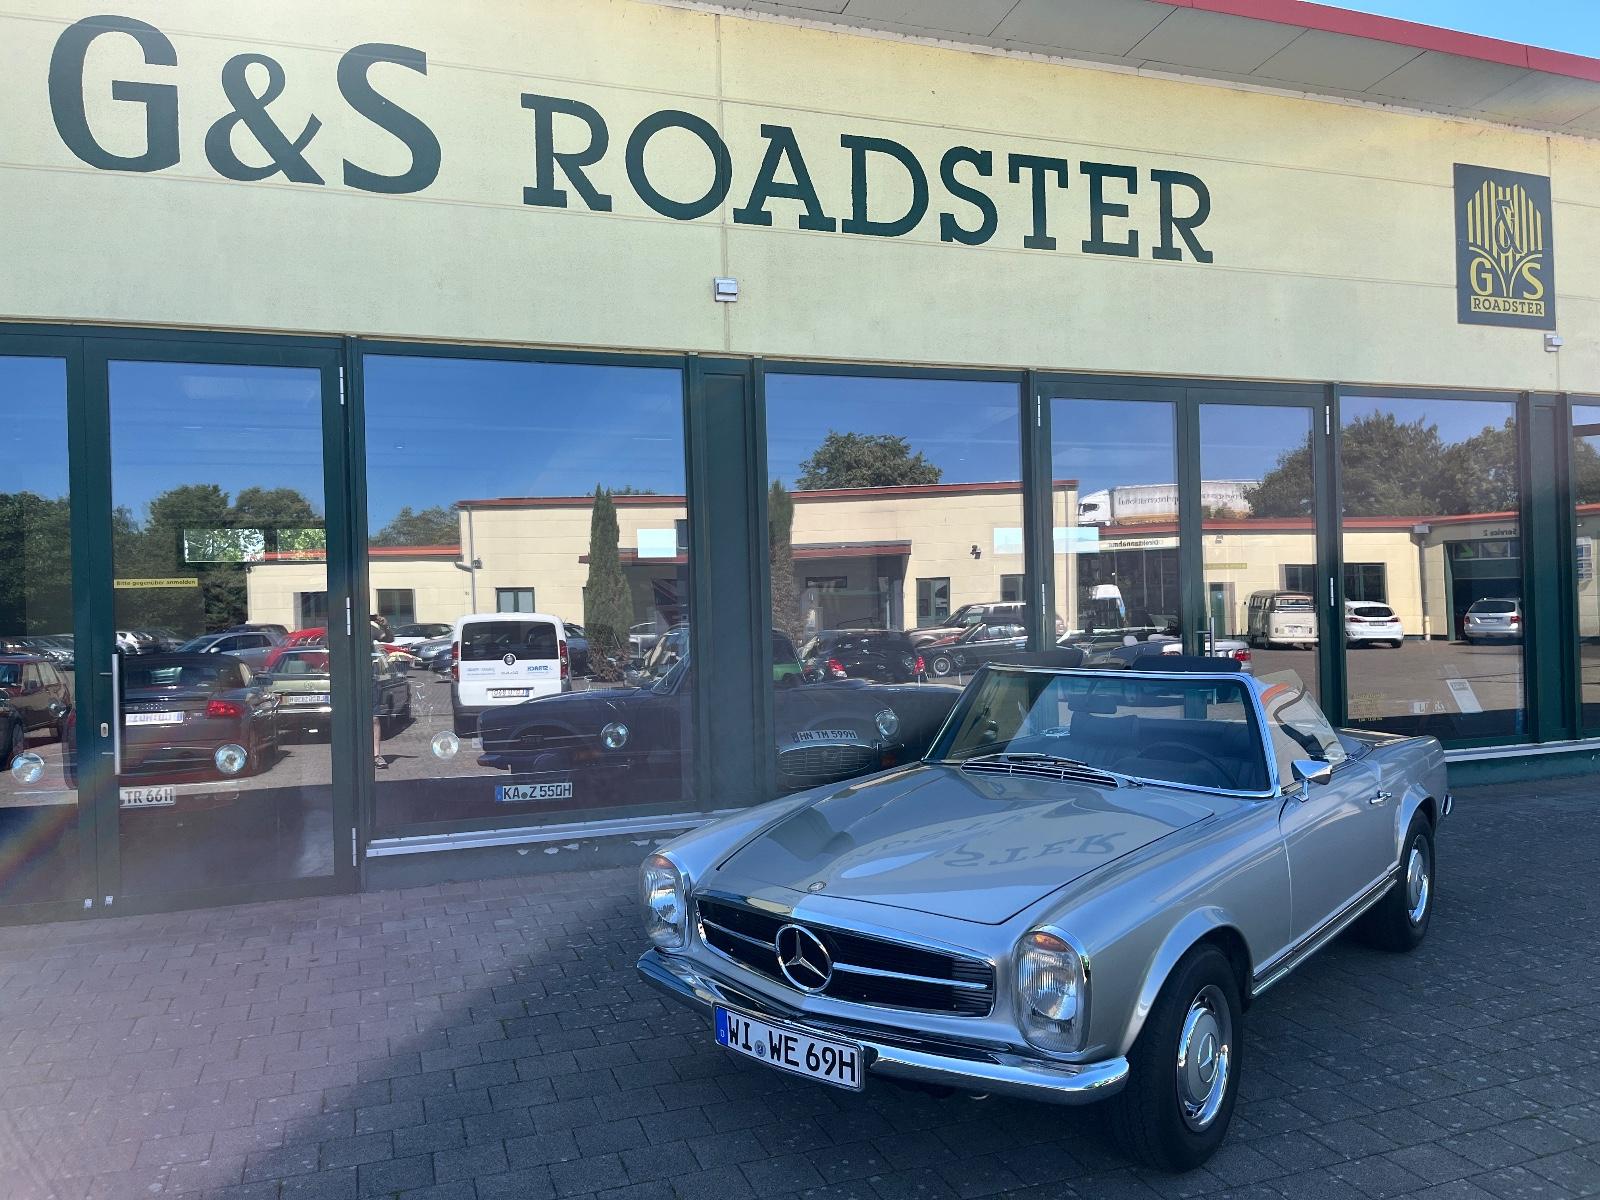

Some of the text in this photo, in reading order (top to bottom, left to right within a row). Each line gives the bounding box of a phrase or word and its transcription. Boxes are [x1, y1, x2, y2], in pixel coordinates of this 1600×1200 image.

[48, 14, 1213, 263] G&S ROADSTER
[1473, 297, 1543, 315] ROADSTER
[125, 788, 173, 804] TR 66H
[503, 784, 571, 800] KA Z 550H
[728, 1015, 753, 1052] WI
[768, 1030, 800, 1068] WE
[805, 1042, 856, 1083] 69H
